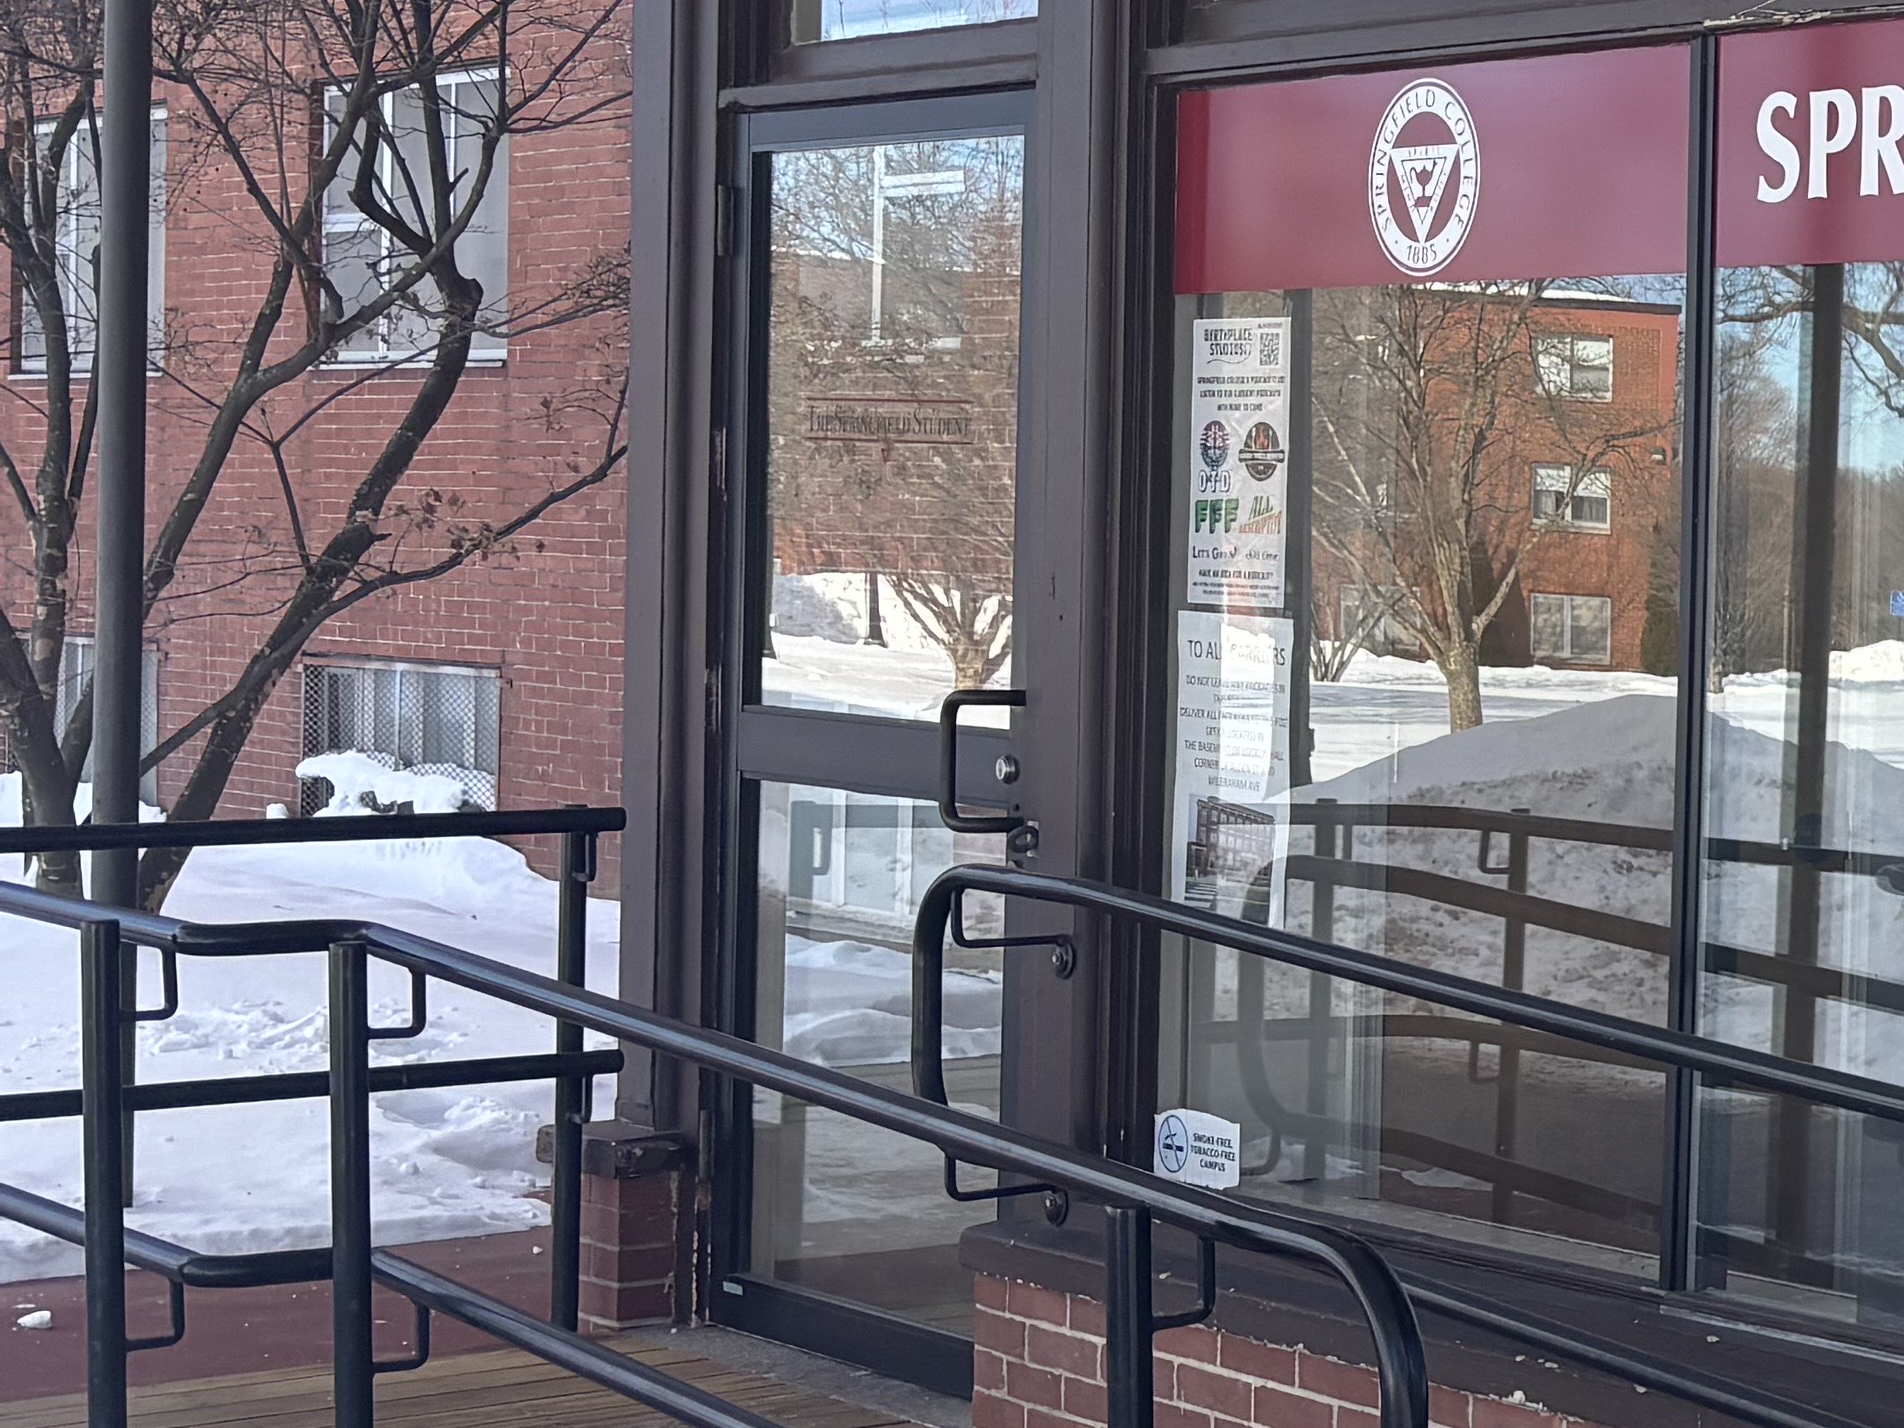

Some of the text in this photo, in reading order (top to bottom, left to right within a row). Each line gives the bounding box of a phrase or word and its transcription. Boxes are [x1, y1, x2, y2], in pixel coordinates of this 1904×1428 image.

[1375, 89, 1474, 233] SPRINGFIELD COLLEGE
[1406, 243, 1438, 264] 1885
[1195, 498, 1240, 534] FFF
[1187, 639, 1203, 659] TO
[1205, 641, 1223, 661] AL
